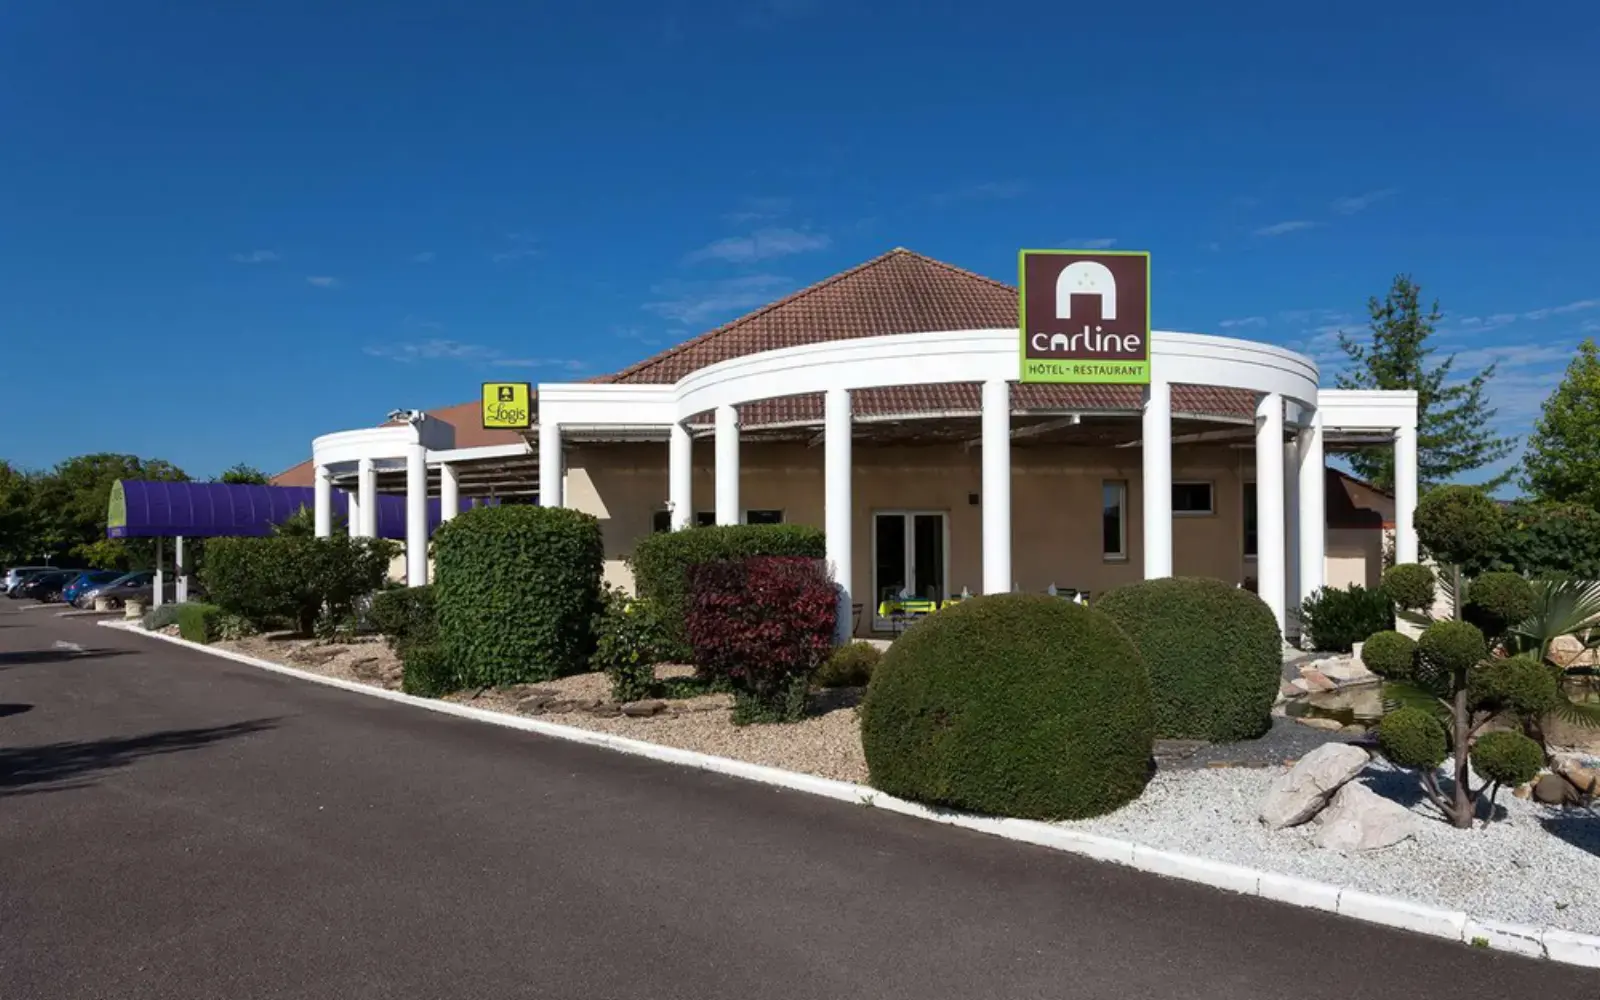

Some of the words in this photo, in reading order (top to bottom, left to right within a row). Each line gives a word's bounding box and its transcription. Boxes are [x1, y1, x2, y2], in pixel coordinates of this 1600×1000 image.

[1031, 326, 1141, 352] carline
[1029, 364, 1064, 375] HÔTEL
[1073, 365, 1143, 376] RESTAURANT
[486, 402, 526, 424] Logis
